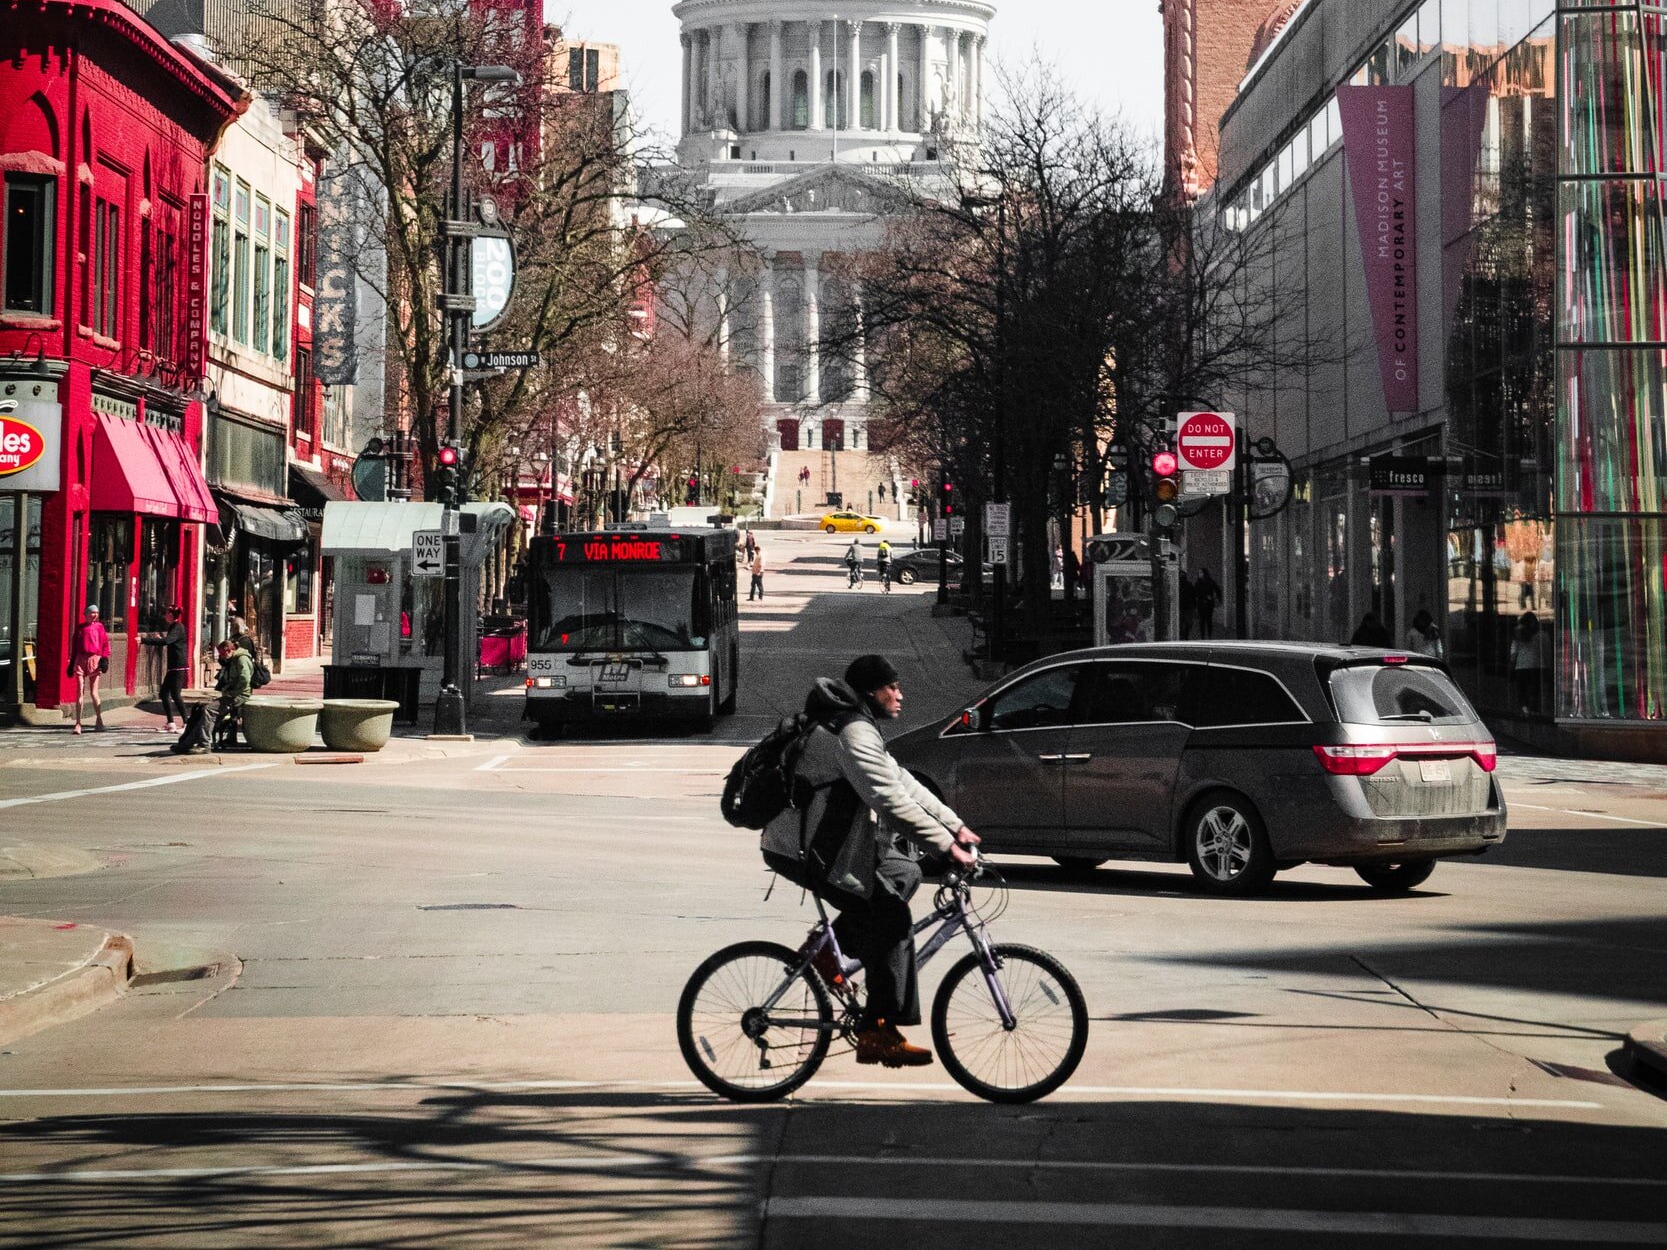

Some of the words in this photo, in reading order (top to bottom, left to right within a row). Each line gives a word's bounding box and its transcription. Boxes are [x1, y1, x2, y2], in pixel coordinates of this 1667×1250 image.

[1377, 100, 1389, 172] MUSEUM
[1393, 159, 1404, 191] ART
[1377, 178, 1389, 258] MADISON
[192, 200, 201, 274] NOODLES
[474, 252, 487, 310] BLOCK
[486, 237, 508, 310] 200
[1394, 199, 1406, 353] CONTEMPORARY
[191, 281, 200, 291] &
[190, 298, 200, 370] COMPANY
[487, 353, 529, 366] Johnson
[1395, 358, 1406, 381] OF
[1187, 424, 1202, 434] DO
[1204, 424, 1225, 434] NOT
[1189, 449, 1223, 458] ENTER
[1389, 471, 1424, 484] fresco
[417, 535, 440, 546] ONE
[417, 548, 440, 558] WAY
[557, 543, 566, 561] 7
[584, 543, 608, 561] VIA
[611, 542, 661, 560] MONROE
[992, 550, 1005, 562] 15
[530, 660, 551, 670] 955
